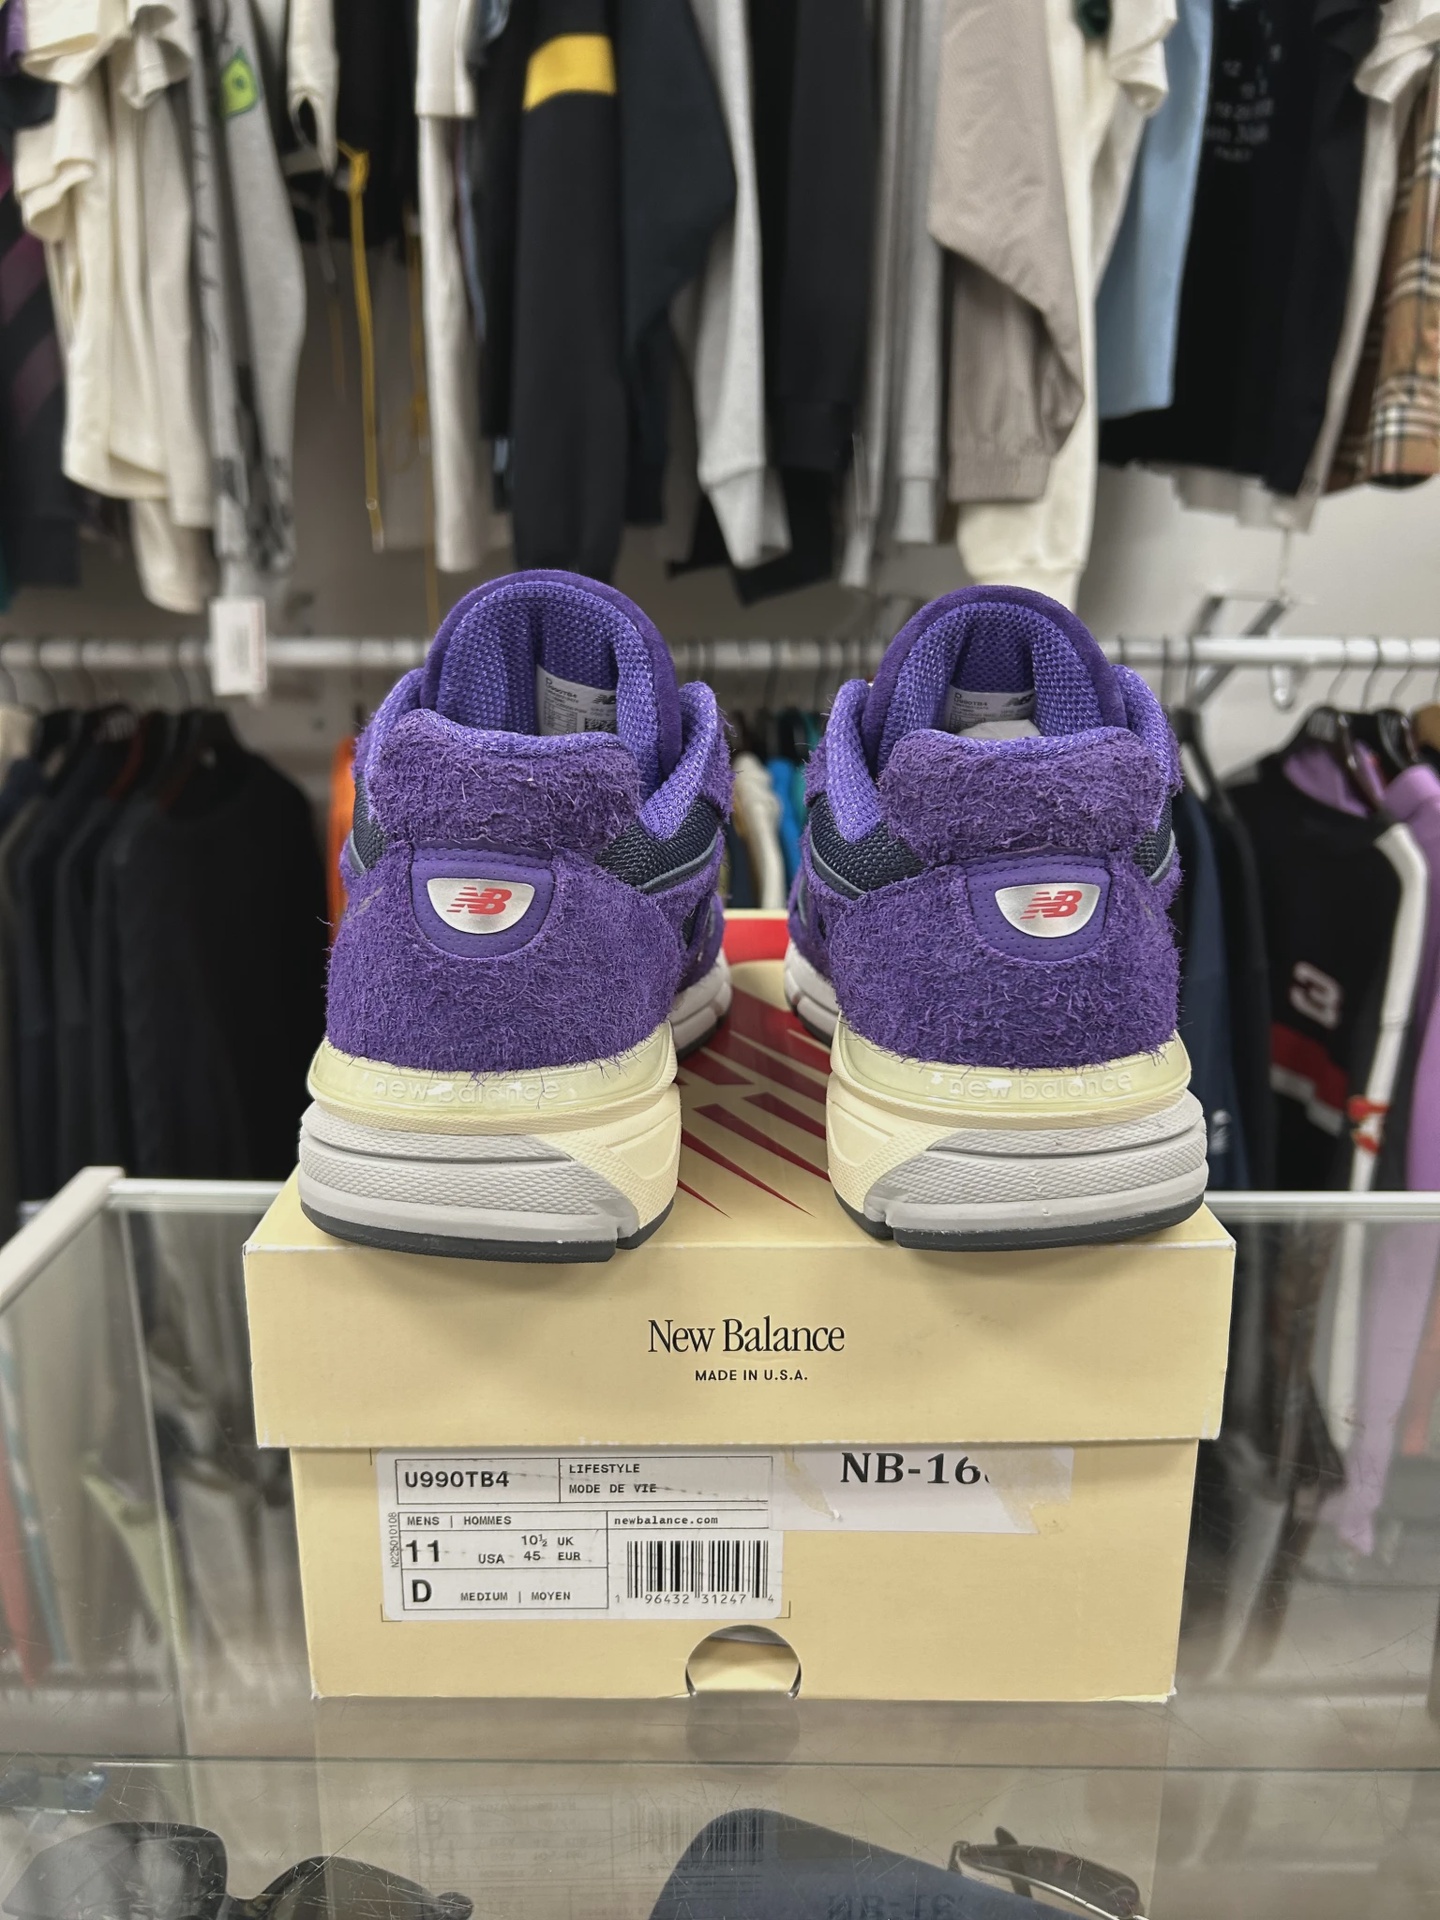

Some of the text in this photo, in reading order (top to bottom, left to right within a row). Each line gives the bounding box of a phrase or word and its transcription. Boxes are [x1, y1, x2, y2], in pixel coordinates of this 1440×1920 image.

[446, 886, 512, 915] NB
[1020, 890, 1083, 920] NB
[1288, 960, 1343, 1030] 3
[373, 1077, 561, 1104] new balance
[948, 1071, 1133, 1100] new balance
[647, 1315, 845, 1353] New Balance
[695, 1369, 808, 1381] MADE IN U.S.A.
[568, 1463, 640, 1474] LIFESTYLE
[840, 1452, 990, 1485] NB-16
[404, 1470, 510, 1488] U990TB4
[568, 1483, 657, 1494] MODE DE VIE
[406, 1515, 512, 1526] MENS HOMMES
[614, 1515, 719, 1526] newbalance.com
[557, 1536, 574, 1547] UK
[405, 1539, 440, 1563] 11
[523, 1550, 582, 1562] 45 EUR
[477, 1553, 506, 1565] USA
[411, 1578, 433, 1603] D
[460, 1590, 571, 1602] MEDIUM MOYEN
[644, 1593, 690, 1605] 96432
[701, 1593, 747, 1605] 31247
[766, 1593, 775, 1604] 4
